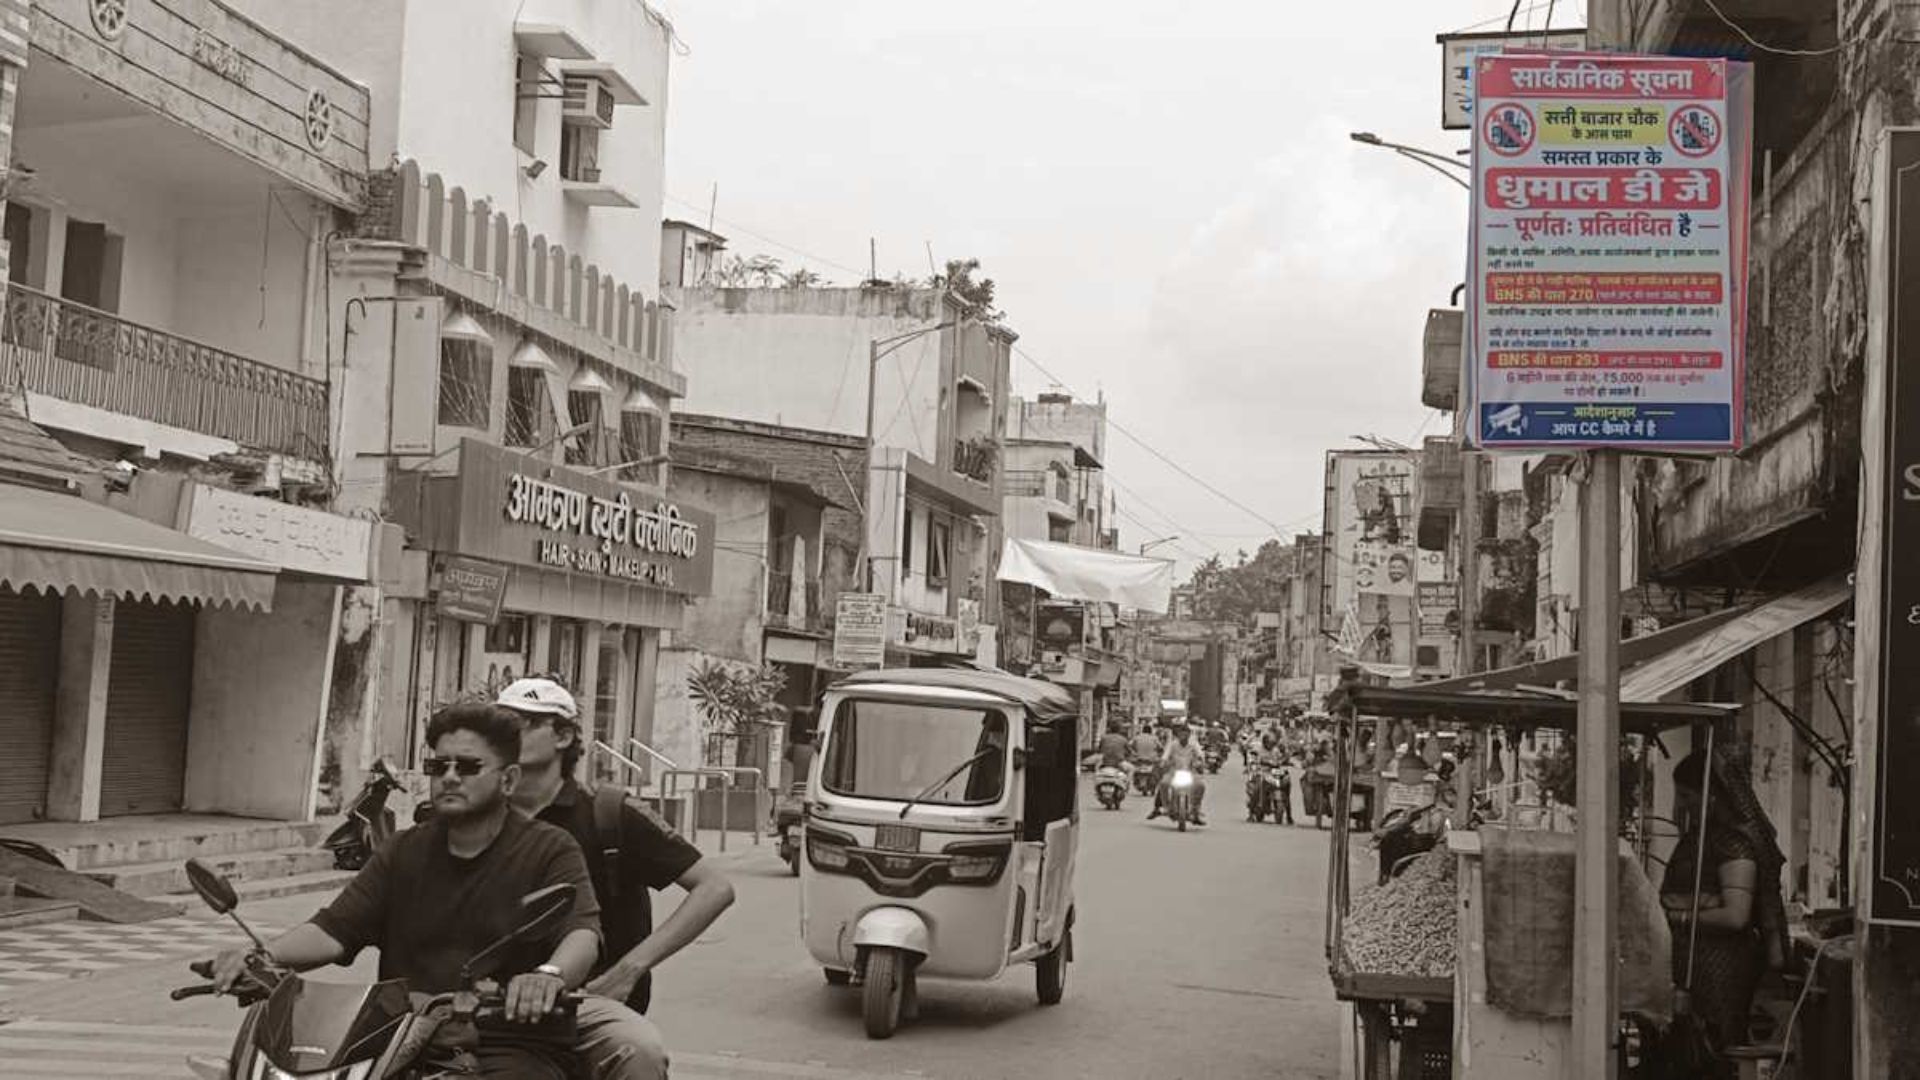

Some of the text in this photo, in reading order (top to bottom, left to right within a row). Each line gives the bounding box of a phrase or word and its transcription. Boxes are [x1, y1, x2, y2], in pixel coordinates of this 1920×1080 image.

[1511, 61, 1692, 96] सार्वजनिक सूचना
[1544, 107, 1658, 126] सत्ती बाजार चौक
[1571, 128, 1581, 139] के
[1585, 129, 1609, 139] आस
[1542, 147, 1662, 165] समस्त प्रकार के
[1497, 169, 1711, 208] धुमाल डी जे
[1514, 212, 1691, 240] पूर्णतः प्रतिबंधित है
[1496, 288, 1523, 300] BNS
[1569, 290, 1593, 300] 270
[1498, 353, 1528, 365] BNS
[1576, 354, 1599, 365] 293
[1551, 420, 1657, 437] आप CC कैमरे में है
[635, 504, 699, 559] क्लीनिक
[542, 540, 568, 566] HAIR
[578, 549, 602, 571] SKIN
[609, 555, 648, 580] MAKEUP
